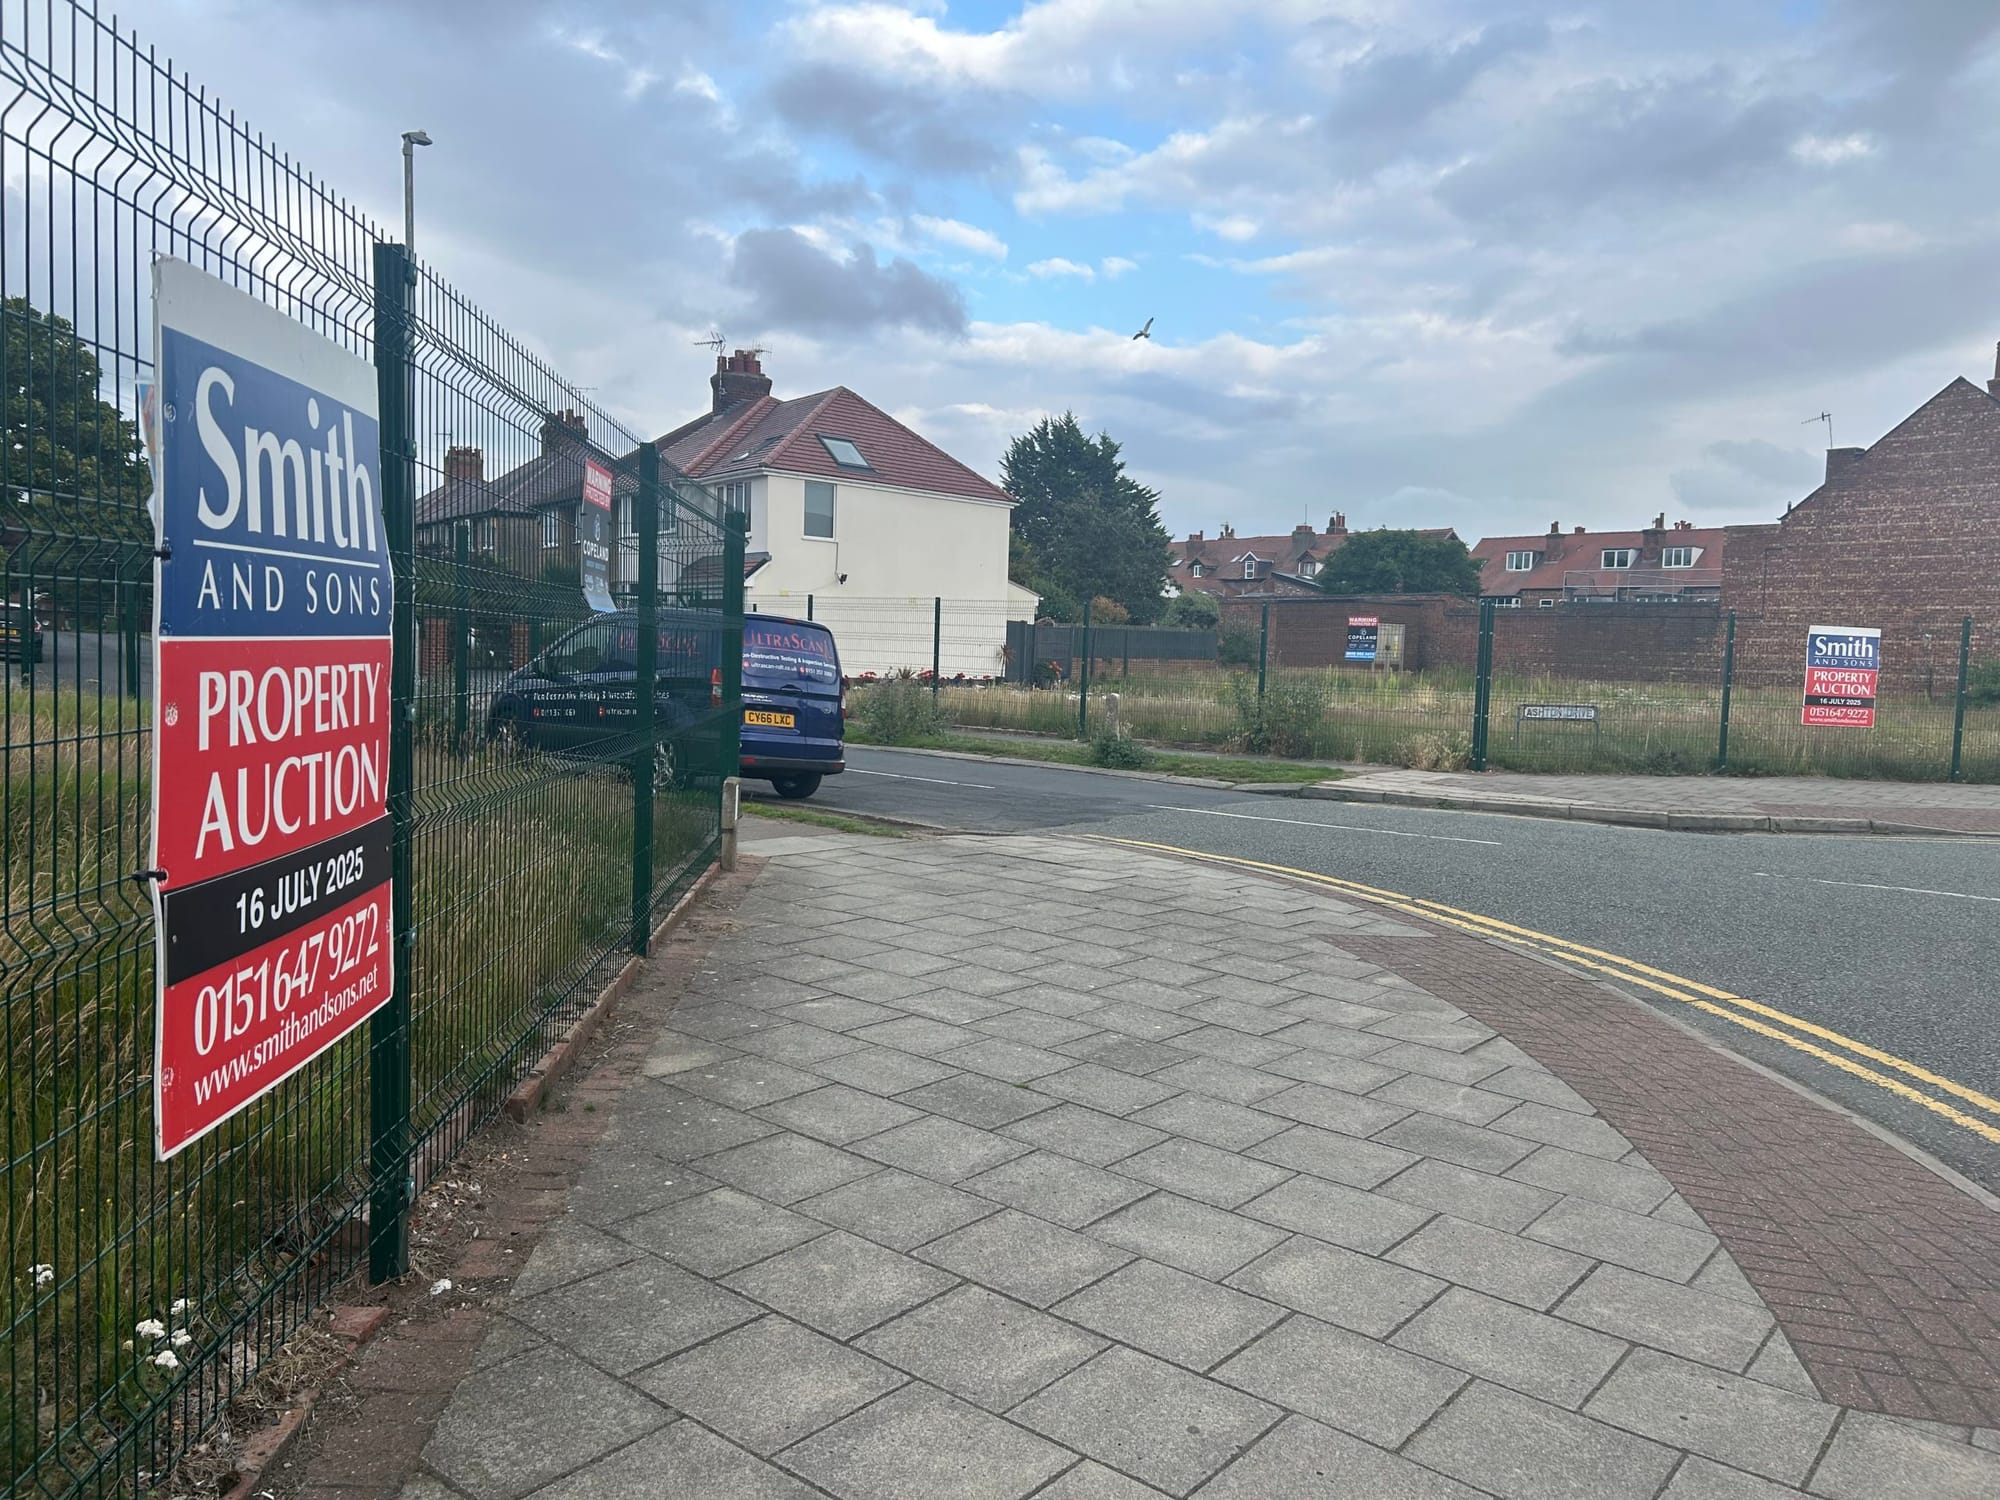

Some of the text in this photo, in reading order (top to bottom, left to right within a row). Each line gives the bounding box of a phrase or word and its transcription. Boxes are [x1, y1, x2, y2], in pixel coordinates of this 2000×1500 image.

[196, 366, 377, 553] Smith
[583, 539, 609, 561] COPELAND
[197, 559, 380, 617] AND SONS
[1814, 658, 1838, 666] AND
[1815, 636, 1873, 657] Smith
[1812, 682, 1870, 695] AUCTION
[1814, 670, 1871, 683] PROPERTY
[199, 662, 380, 751] PROPERTY
[748, 712, 791, 726] CY66 LXC
[1847, 709, 1869, 719] 9272
[195, 739, 380, 860] AUCTION
[236, 846, 364, 934] 16 JULY 2025
[328, 902, 379, 981] 9272
[193, 964, 378, 1106] www.smithandsons.net
